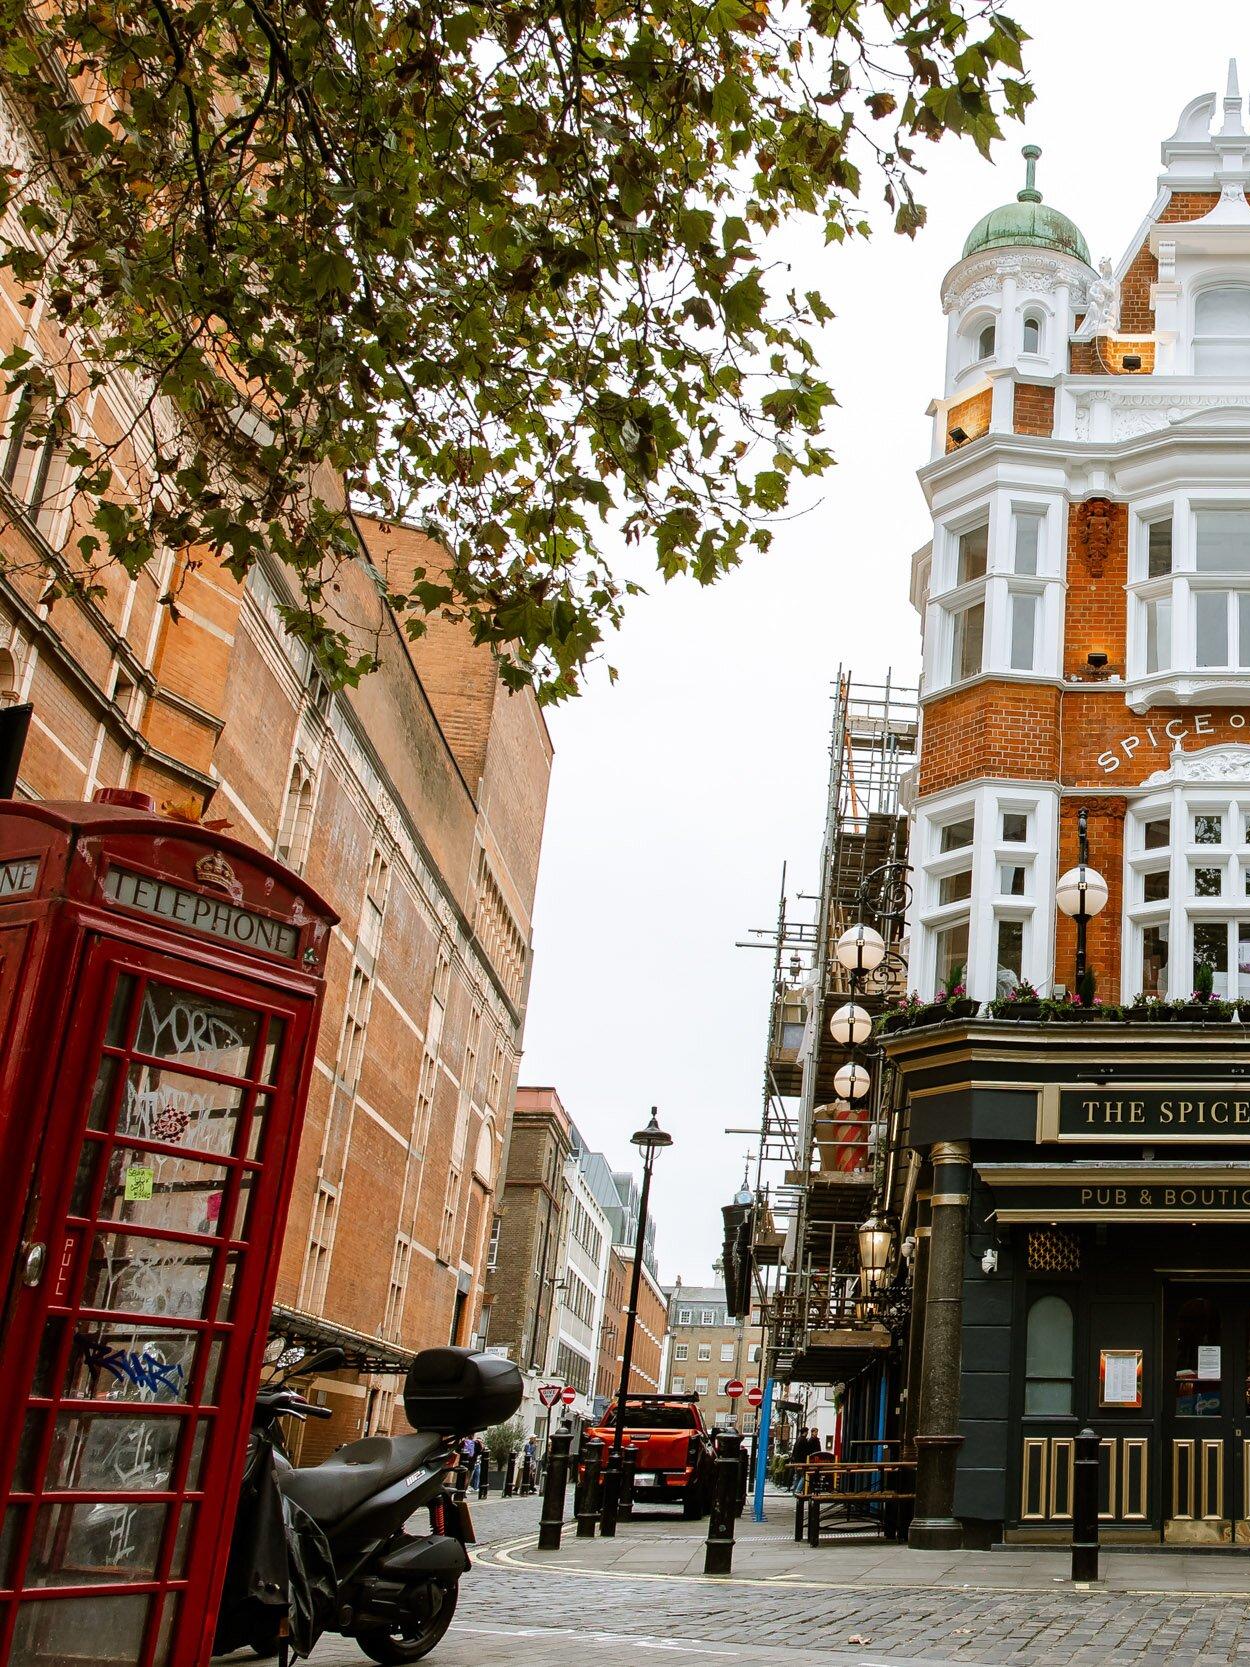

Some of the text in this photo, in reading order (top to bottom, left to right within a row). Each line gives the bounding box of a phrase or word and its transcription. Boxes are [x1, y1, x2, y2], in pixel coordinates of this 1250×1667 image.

[1097, 713, 1215, 773] SPICE
[110, 870, 290, 954] TELEPHONE
[1083, 1101, 1146, 1124] THE
[1160, 1101, 1250, 1124] SPICE
[1081, 1189, 1127, 1205] PUB
[1140, 1189, 1153, 1205] &
[55, 1238, 74, 1295] PULL
